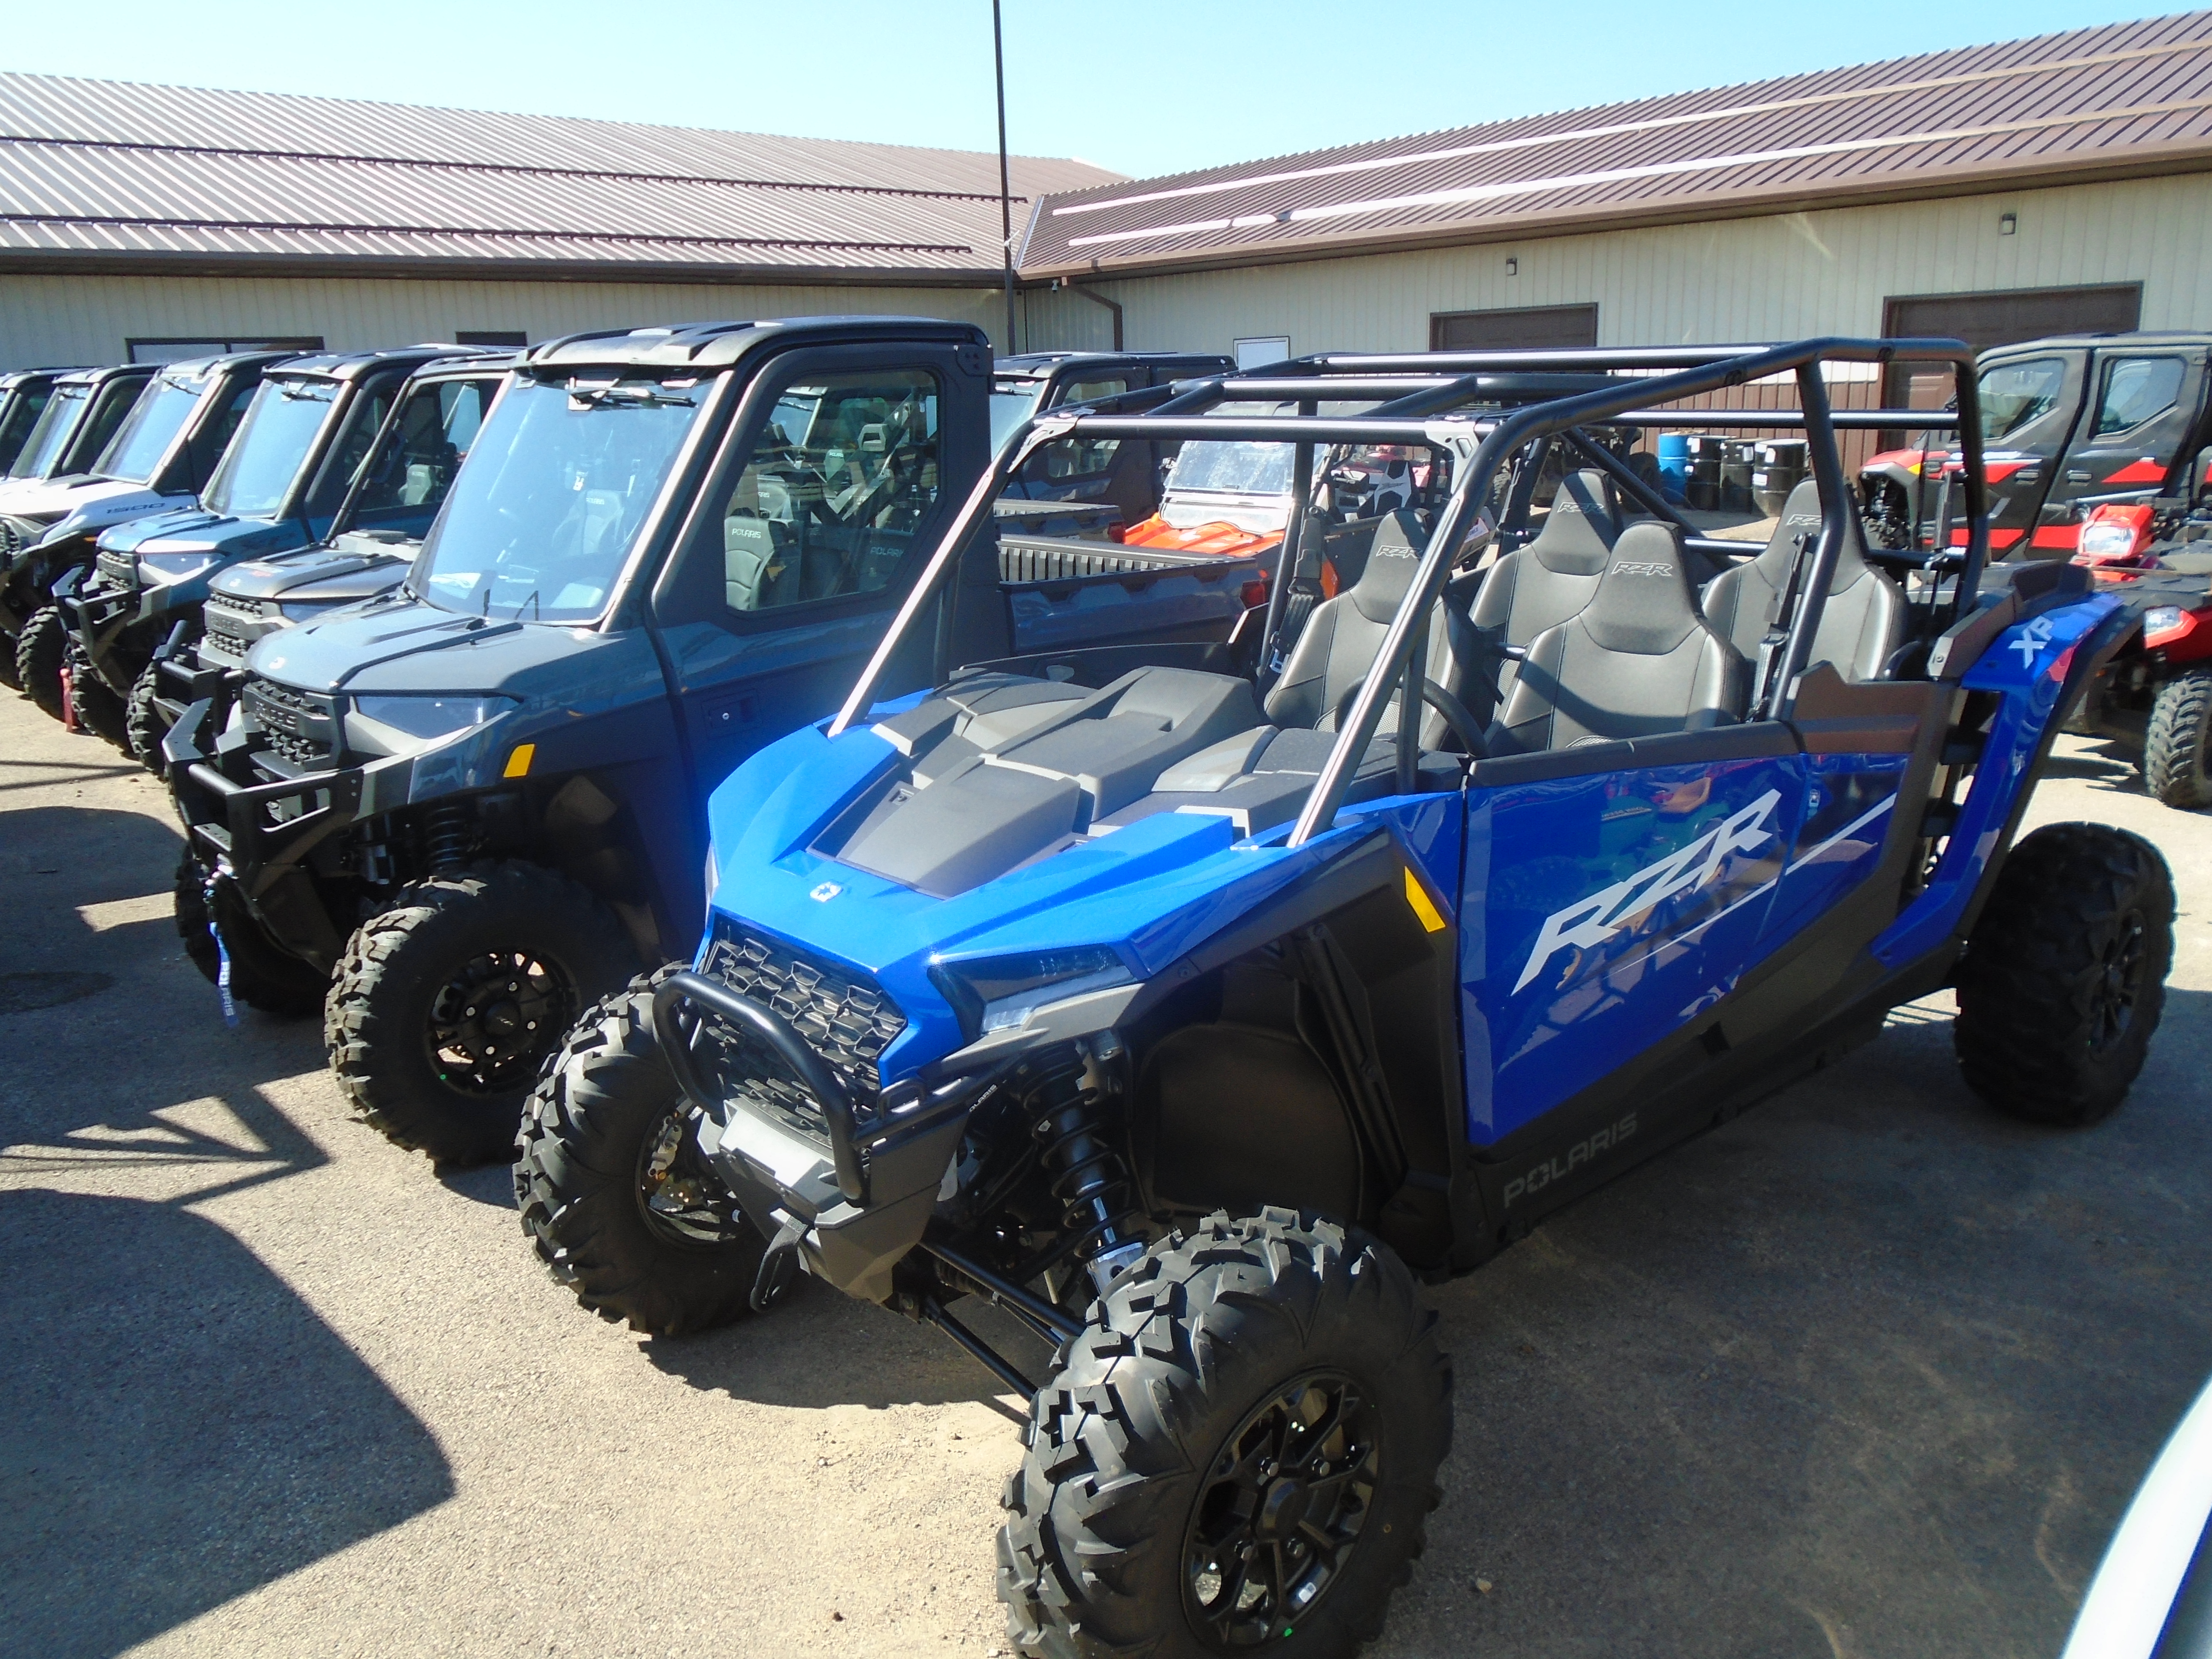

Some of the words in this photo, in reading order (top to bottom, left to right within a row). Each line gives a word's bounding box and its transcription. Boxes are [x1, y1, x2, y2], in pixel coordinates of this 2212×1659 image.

[107, 502, 165, 514] 1500
[1557, 501, 1604, 513] RZR
[1785, 514, 1822, 526] RZ
[732, 528, 762, 538] POLARIS
[1611, 561, 1673, 576] RZR
[2008, 616, 2054, 669] XP
[1511, 788, 1781, 997] RZR
[218, 962, 234, 1016] POLARIS
[969, 1084, 997, 1112] OLARIS
[1504, 1112, 1638, 1209] POLARIS
